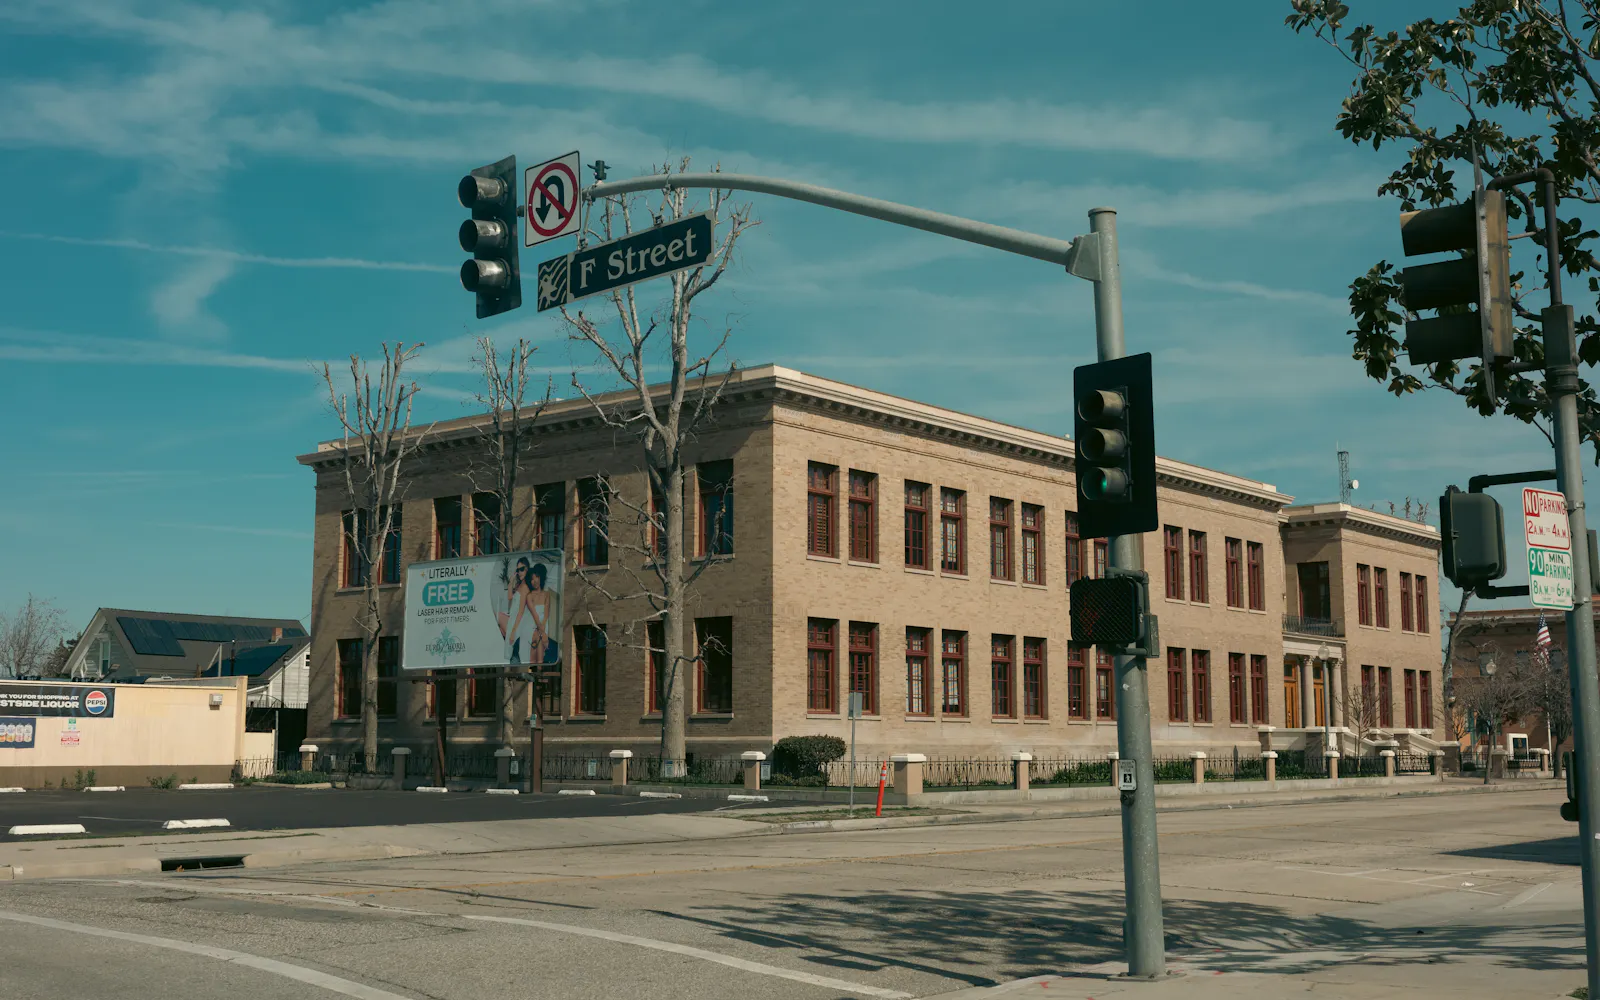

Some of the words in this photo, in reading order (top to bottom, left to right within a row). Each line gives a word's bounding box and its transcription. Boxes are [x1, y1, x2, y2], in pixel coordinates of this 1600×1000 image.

[579, 257, 596, 289] F
[607, 228, 698, 280] Street
[1525, 491, 1539, 514] NO
[1540, 498, 1566, 515] PARKING
[1530, 550, 1544, 572] 90
[1548, 552, 1566, 565] MIN.
[429, 566, 469, 579] LITERALLY
[1545, 563, 1571, 581] PARKING
[427, 583, 469, 603] FREE
[417, 608, 435, 617] LASER
[435, 607, 449, 615] HAIR
[449, 604, 478, 615] REMOVAL
